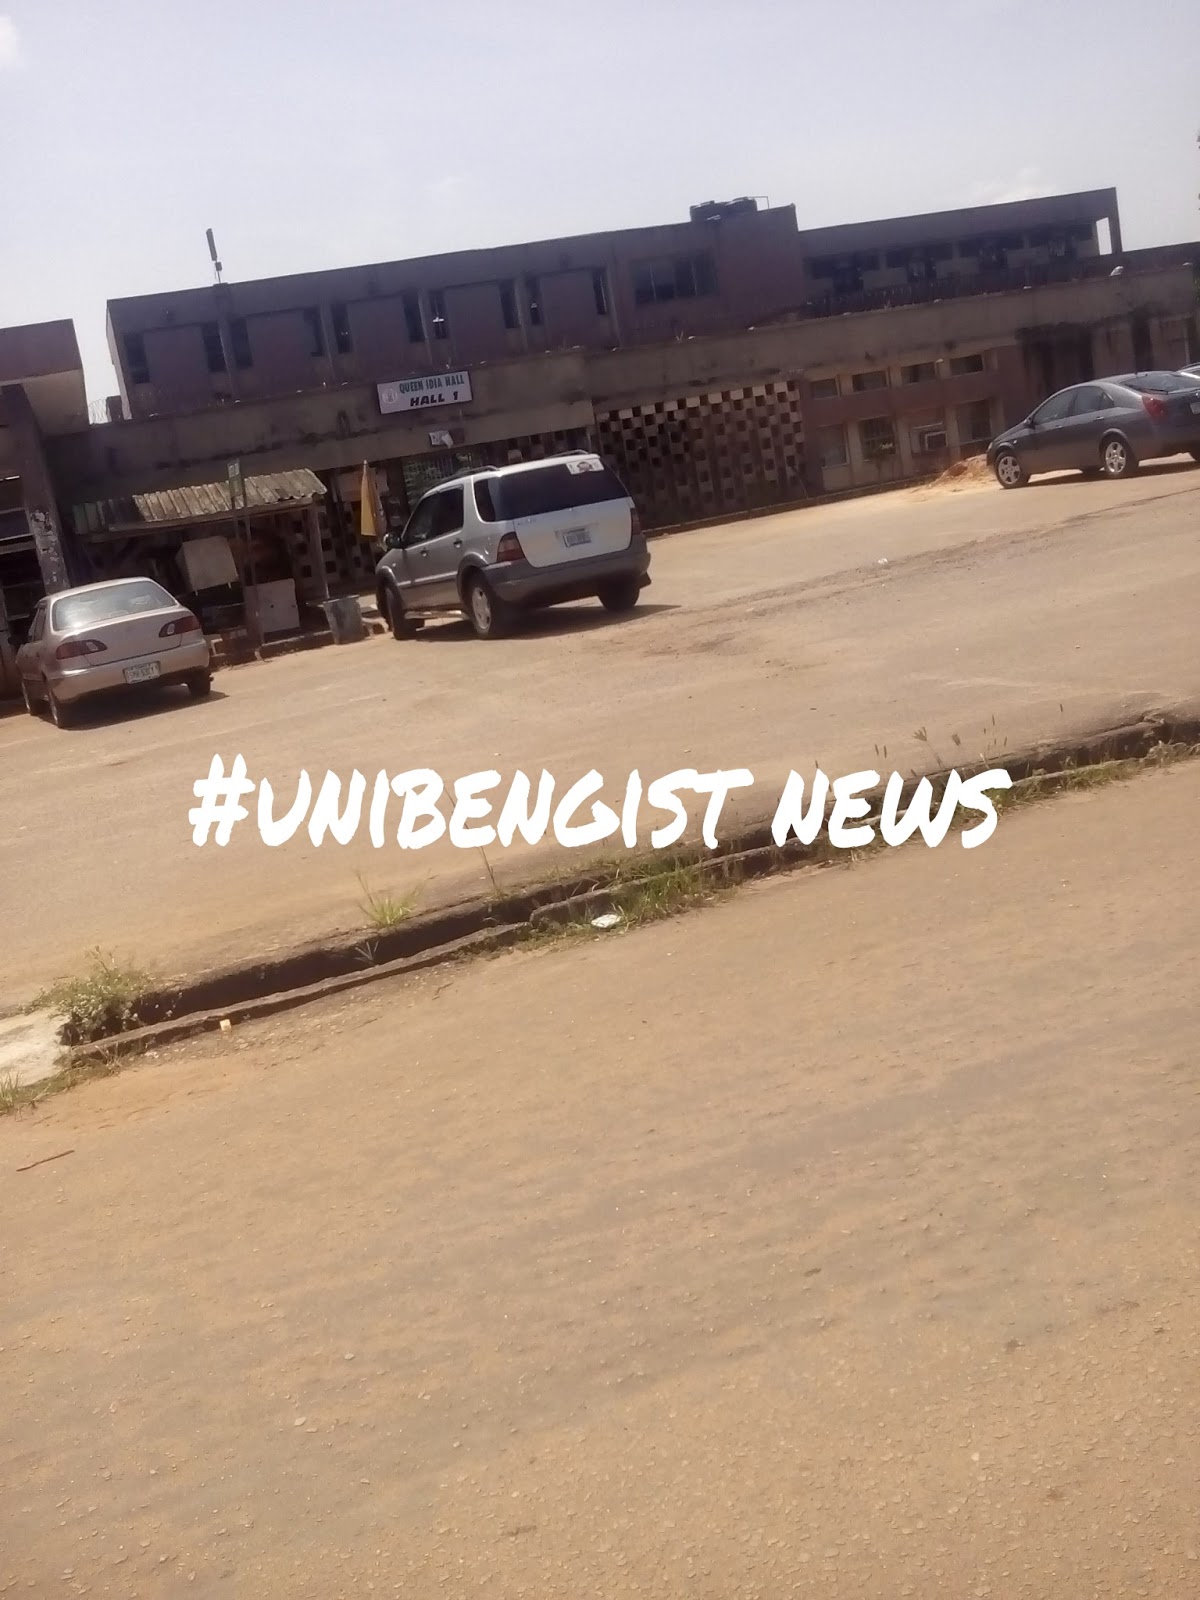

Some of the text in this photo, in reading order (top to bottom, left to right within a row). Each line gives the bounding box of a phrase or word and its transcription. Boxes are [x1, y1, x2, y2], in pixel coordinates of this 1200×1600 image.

[399, 375, 464, 394] QUEEN IDIA HALL
[410, 391, 458, 407] HALL 1
